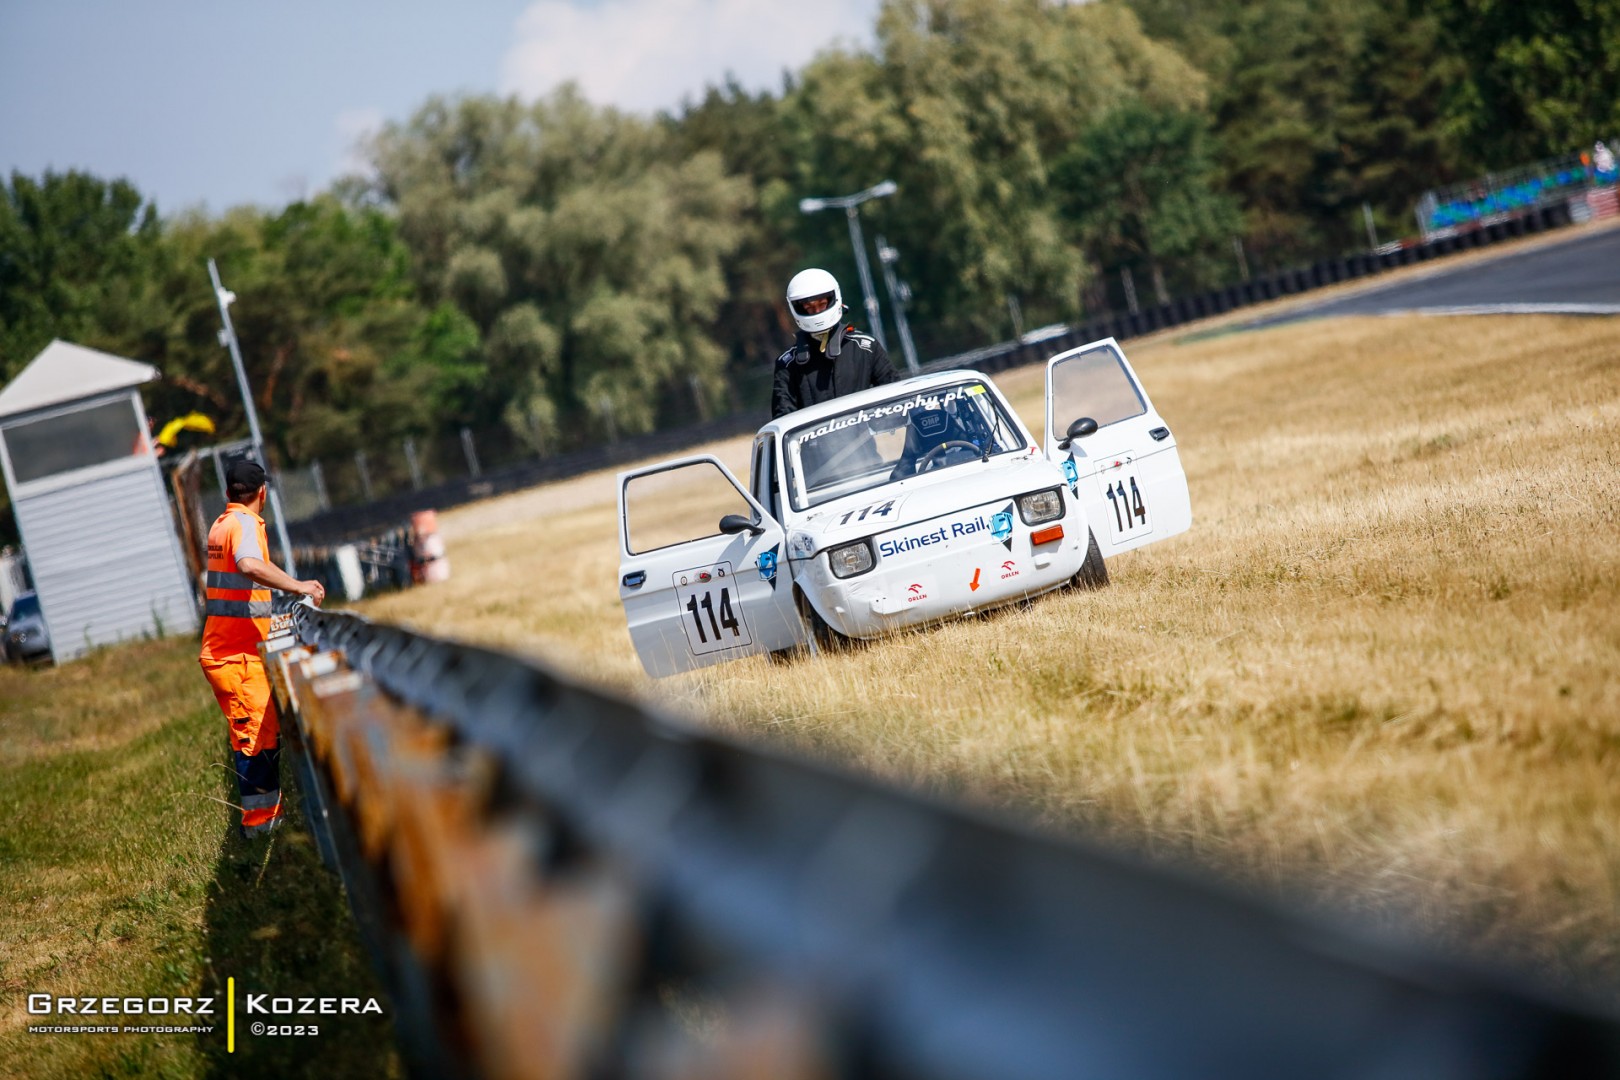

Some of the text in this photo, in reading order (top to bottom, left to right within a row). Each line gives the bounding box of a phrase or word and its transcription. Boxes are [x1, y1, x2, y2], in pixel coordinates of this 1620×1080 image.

[799, 386, 965, 444] maluch-trophy.pl
[921, 416, 940, 427] OMP
[840, 500, 896, 526] 114
[1106, 476, 1146, 532] 114
[879, 516, 986, 557] Skinest Rail
[1001, 570, 1020, 579] ORLEN
[908, 594, 928, 602] ORLEN
[687, 587, 740, 643] 114
